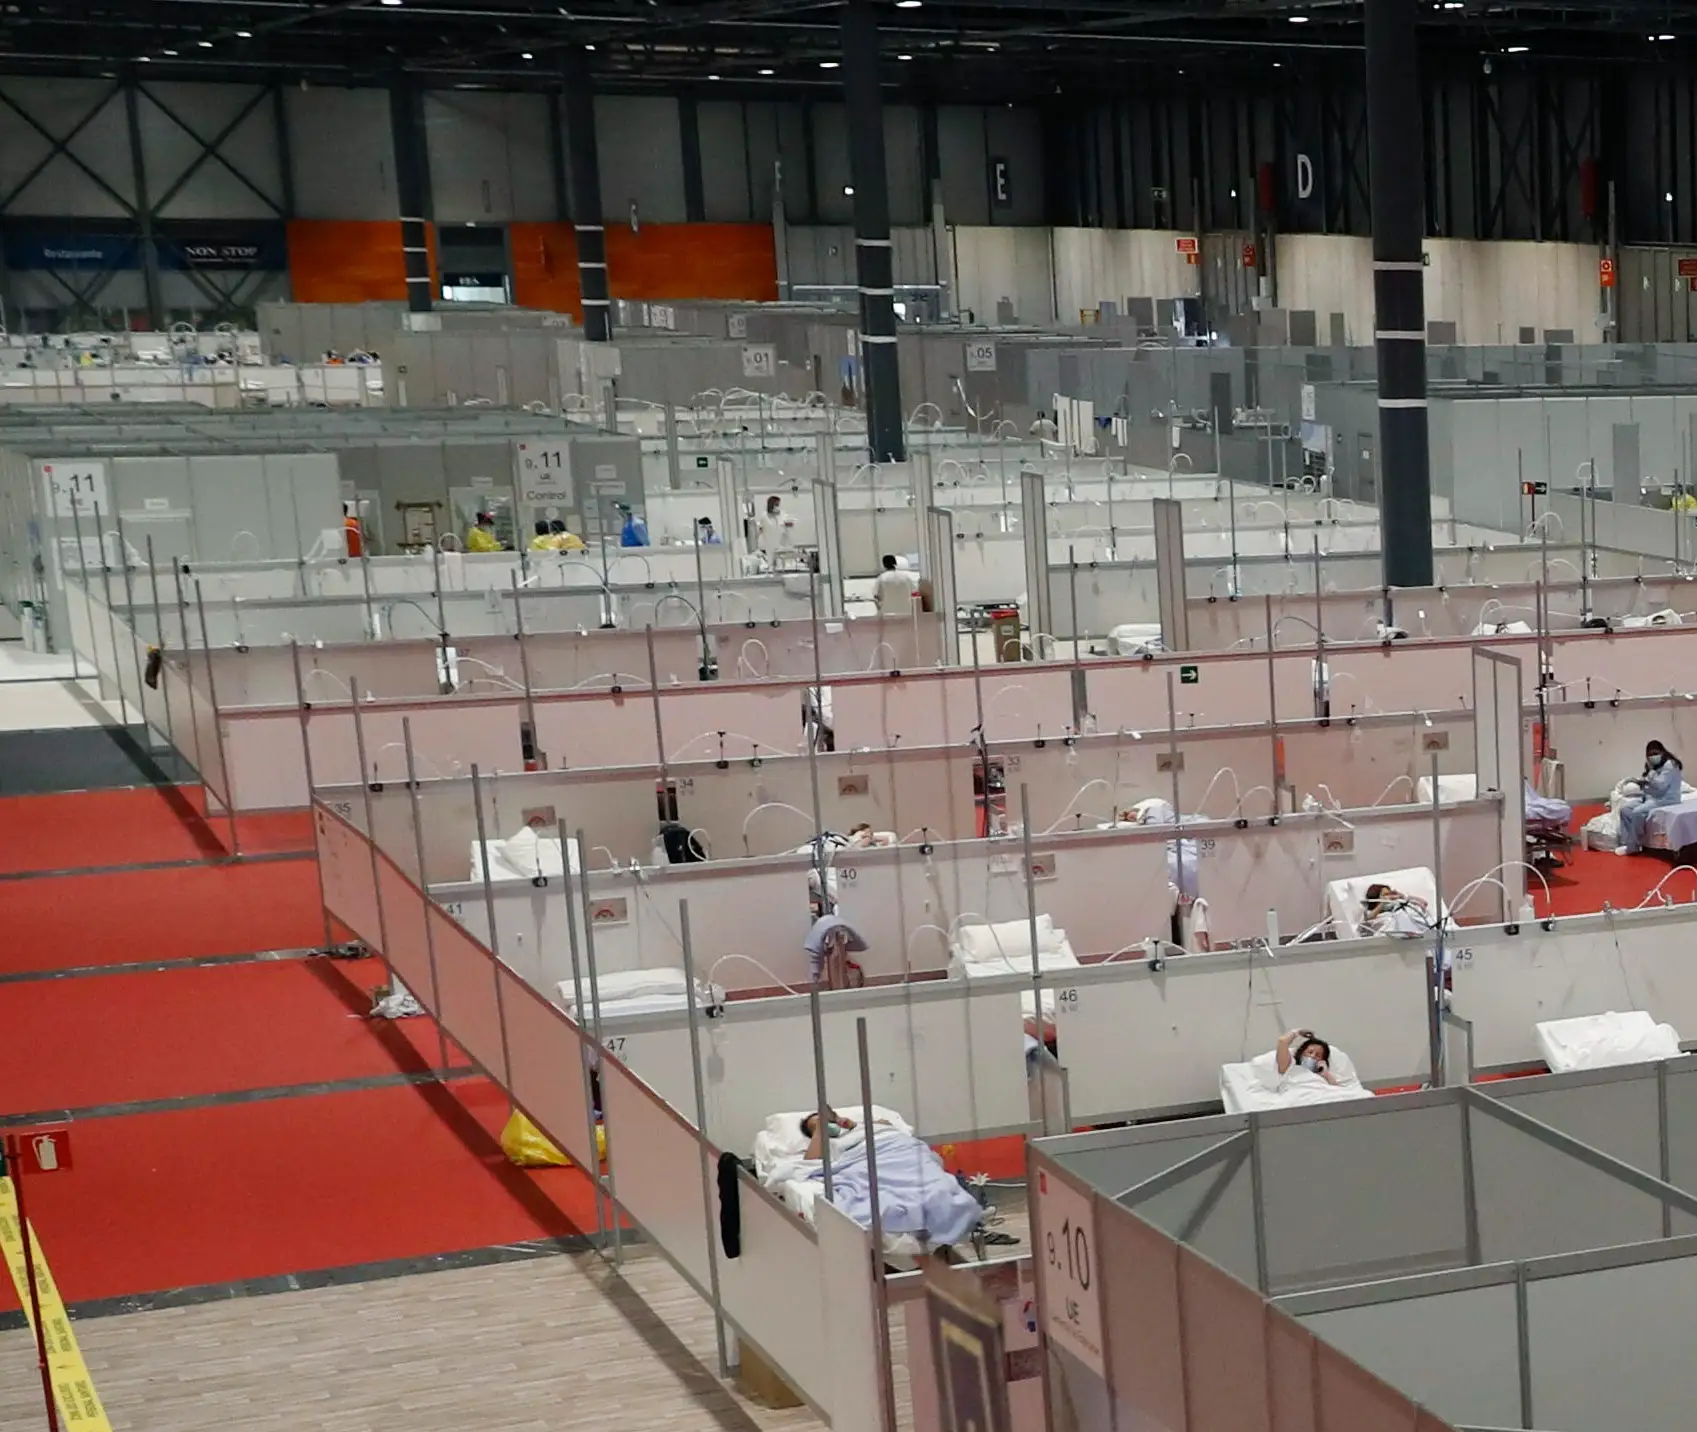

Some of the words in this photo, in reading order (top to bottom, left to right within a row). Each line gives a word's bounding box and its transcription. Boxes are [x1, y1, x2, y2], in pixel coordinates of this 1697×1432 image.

[996, 164, 1007, 201] E
[1297, 154, 1313, 199] D
[526, 490, 567, 501] Control
[1201, 839, 1216, 850] 39
[840, 869, 857, 880] 40
[1456, 948, 1473, 961] 45
[1059, 990, 1078, 1003] 46
[607, 1037, 626, 1053] 47
[1065, 1295, 1081, 1326] UE
